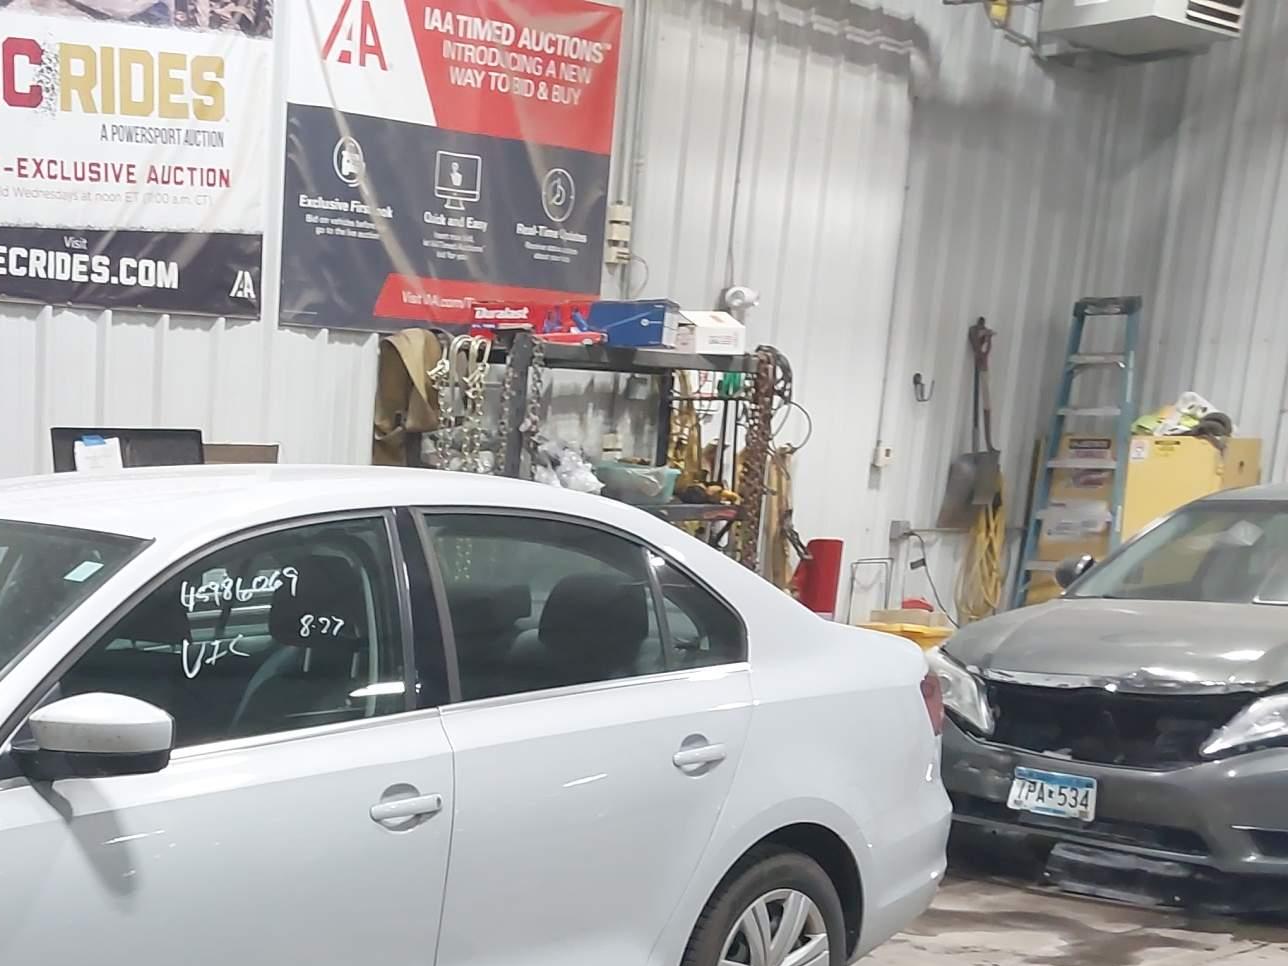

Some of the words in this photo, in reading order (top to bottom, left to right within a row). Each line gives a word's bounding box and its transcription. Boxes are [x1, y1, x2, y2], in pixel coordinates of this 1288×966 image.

[424, 6, 453, 35] IAA
[456, 14, 516, 46] TIMED
[442, 39, 544, 76] INTRODUCING
[545, 60, 556, 78] A
[559, 62, 594, 84] NEW
[56, 42, 226, 122] RIDES
[449, 65, 486, 89] WAY
[488, 71, 510, 93] TO
[511, 76, 535, 97] BID
[536, 81, 549, 100] &
[551, 84, 582, 105] BUY
[100, 123, 108, 142] A
[111, 124, 182, 145] POWERSPORT
[184, 128, 225, 148] AUCTION
[146, 164, 231, 188] AUCTION
[299, 193, 350, 212] Exclusive
[423, 211, 446, 225] Quick
[466, 216, 488, 232] Easy
[64, 235, 88, 250] Visit
[180, 566, 299, 612] 45986069
